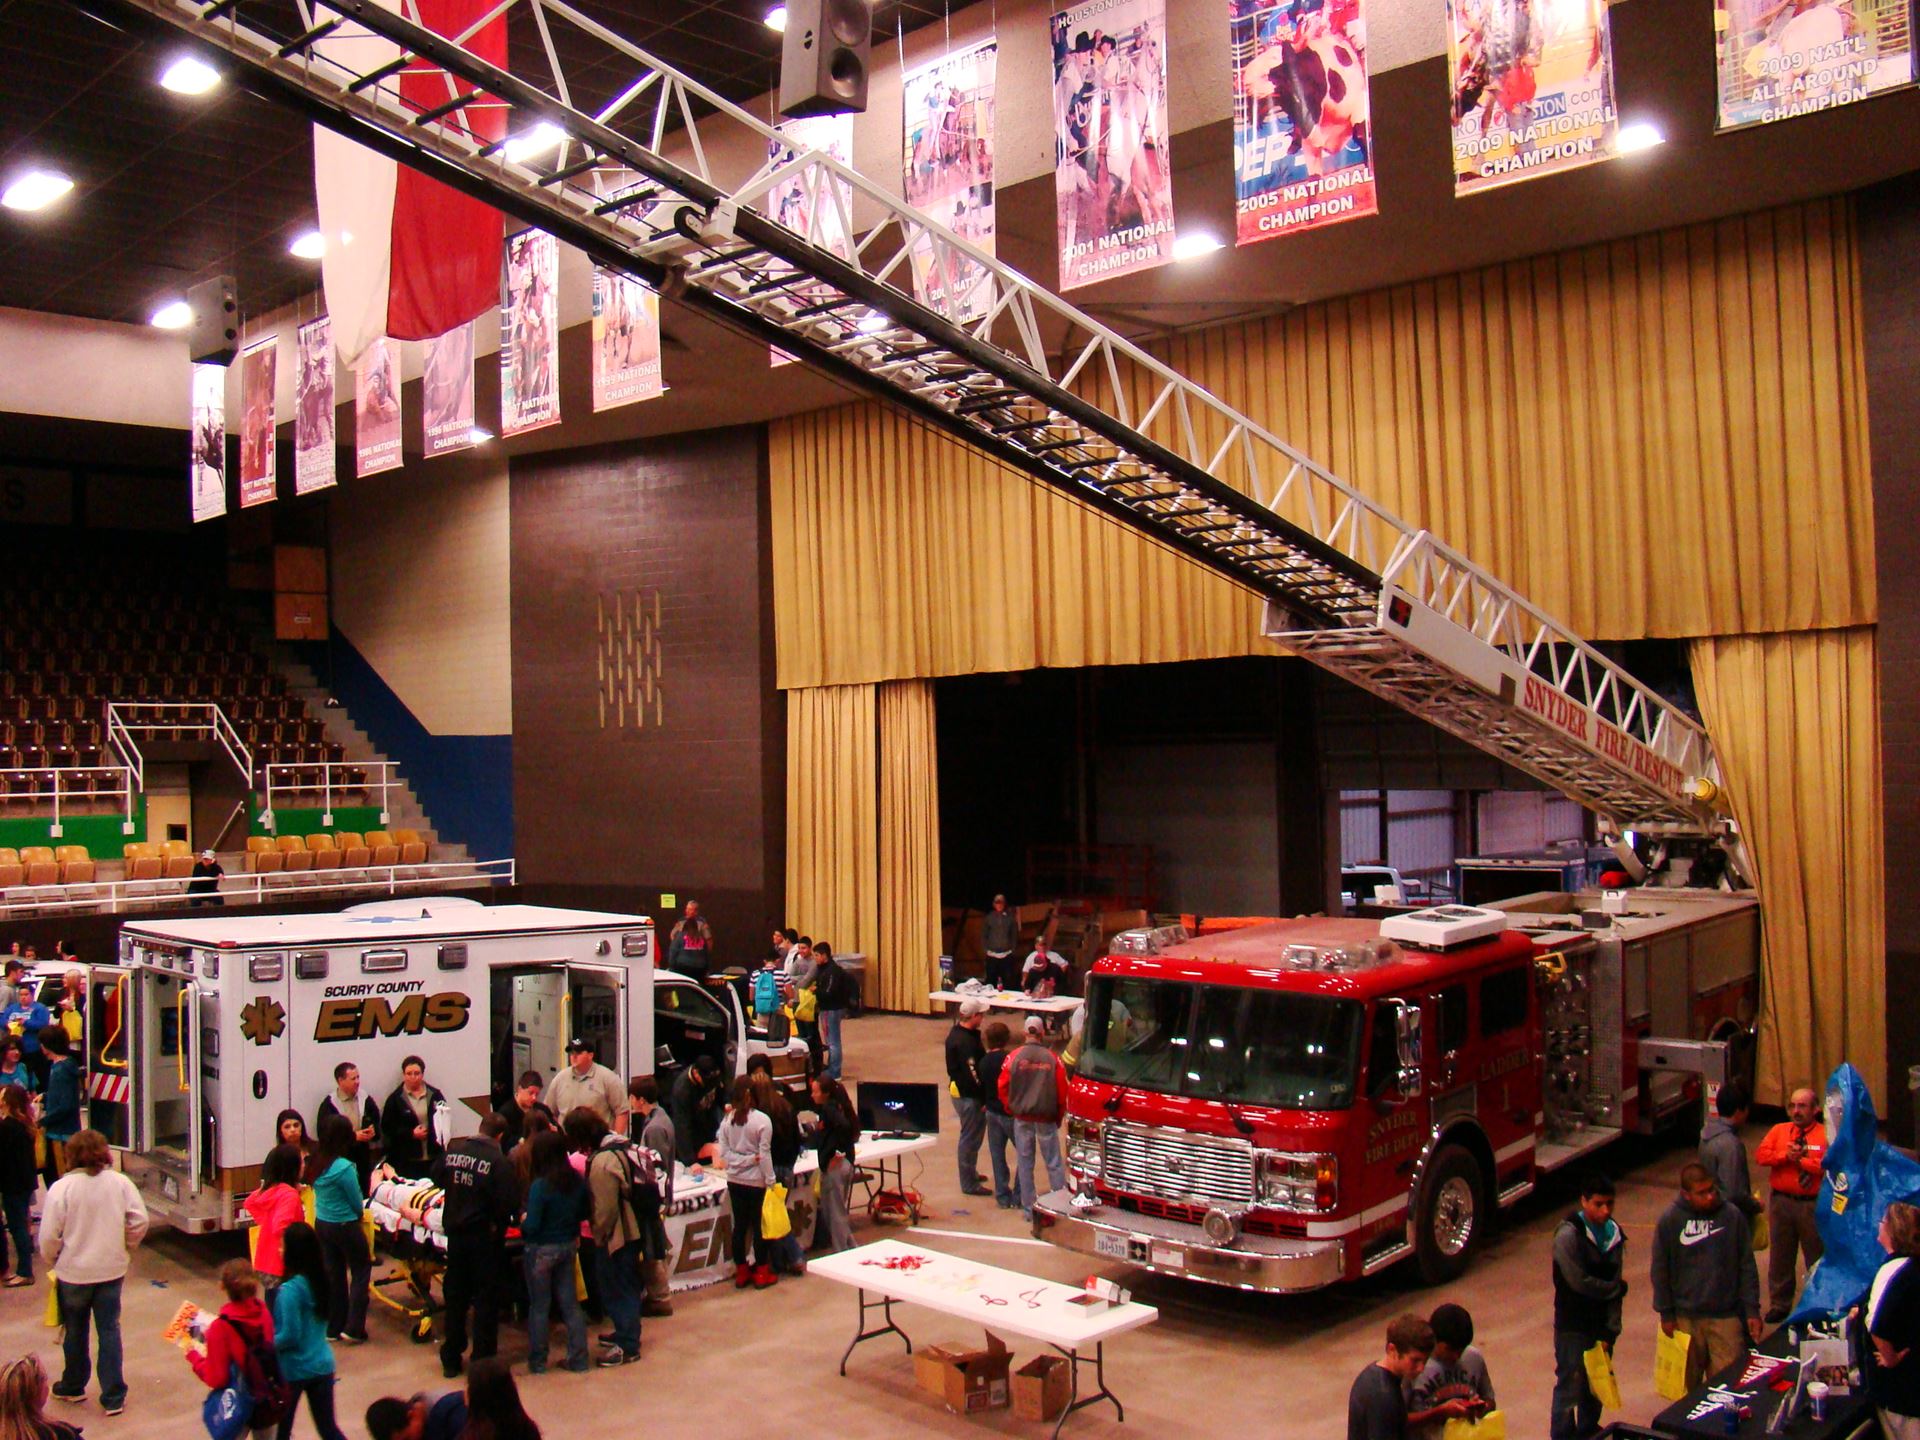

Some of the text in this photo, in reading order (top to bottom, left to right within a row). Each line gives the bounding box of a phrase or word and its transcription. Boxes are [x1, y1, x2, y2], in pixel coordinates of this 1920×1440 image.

[1058, 0, 1113, 28] HOUSTON
[1758, 37, 1867, 77] 2009 NAT'L
[1751, 58, 1878, 104] ALL-AROUND
[1761, 86, 1868, 124] CHAMPION
[1455, 106, 1617, 161] 2009 NATIONAL
[1480, 137, 1593, 178] CHAMPION
[1238, 168, 1374, 214] 2005 NATIONAL
[1259, 196, 1354, 231] CHAMPION
[1062, 218, 1175, 261] 2001 NATIONAL
[1079, 243, 1158, 276] CHAMPION
[605, 382, 652, 401] CHAMPION
[511, 410, 551, 428] CHAMPION
[365, 454, 396, 469] CHAMPION
[1524, 677, 1684, 798] SNYDER FIRE/RESCUE
[324, 981, 424, 998] SCURRY COUNTY
[313, 992, 472, 1043] EMS
[1369, 1111, 1417, 1142] SNYDER
[1365, 1143, 1391, 1164] FIRE
[454, 1170, 474, 1186] EMS
